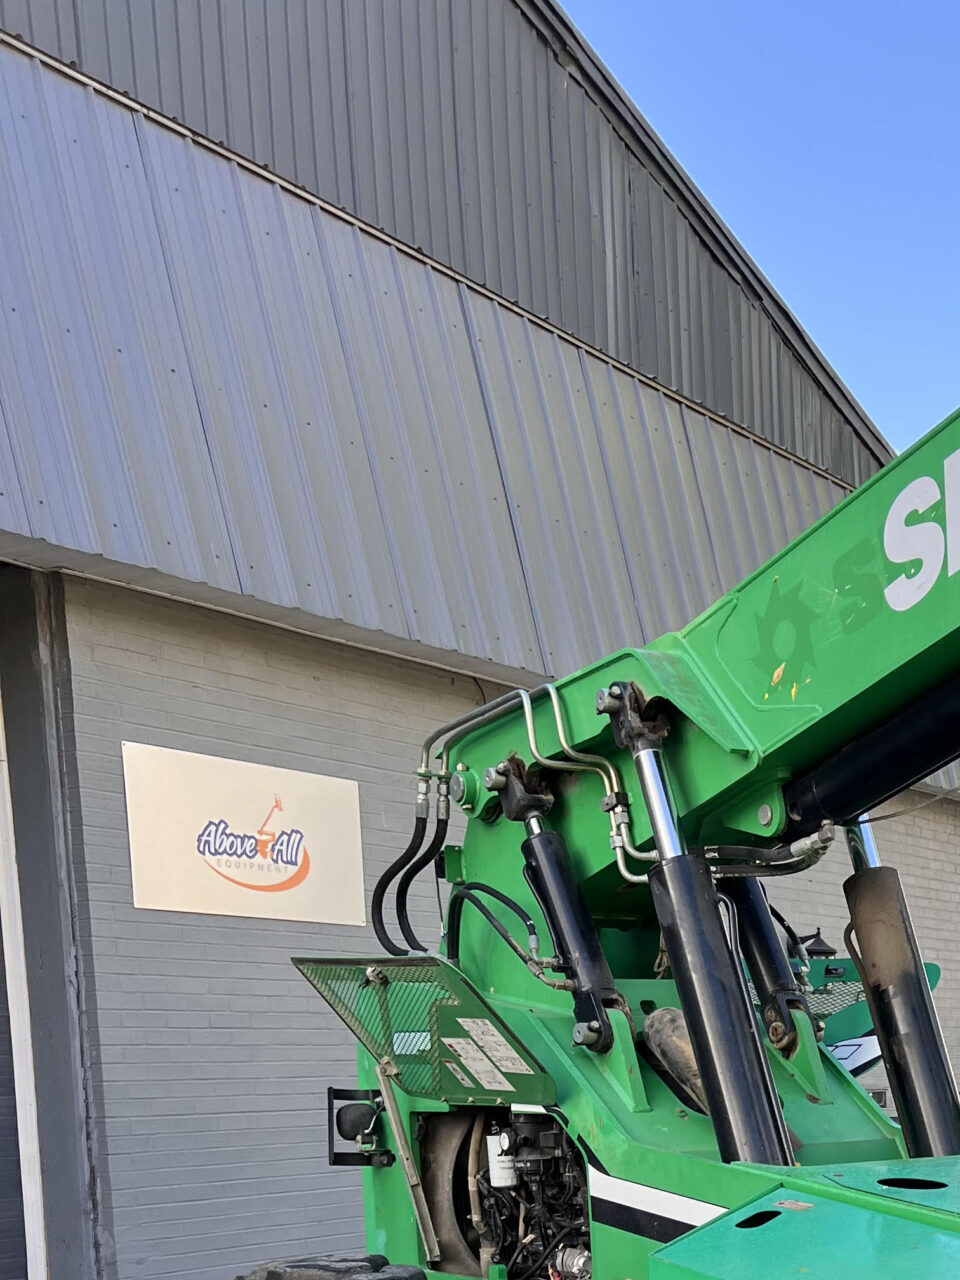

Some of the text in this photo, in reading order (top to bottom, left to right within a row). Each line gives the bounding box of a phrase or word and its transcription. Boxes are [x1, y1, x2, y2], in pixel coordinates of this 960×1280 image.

[197, 819, 304, 866] Above All
[217, 859, 289, 874] EQUIPMENT
